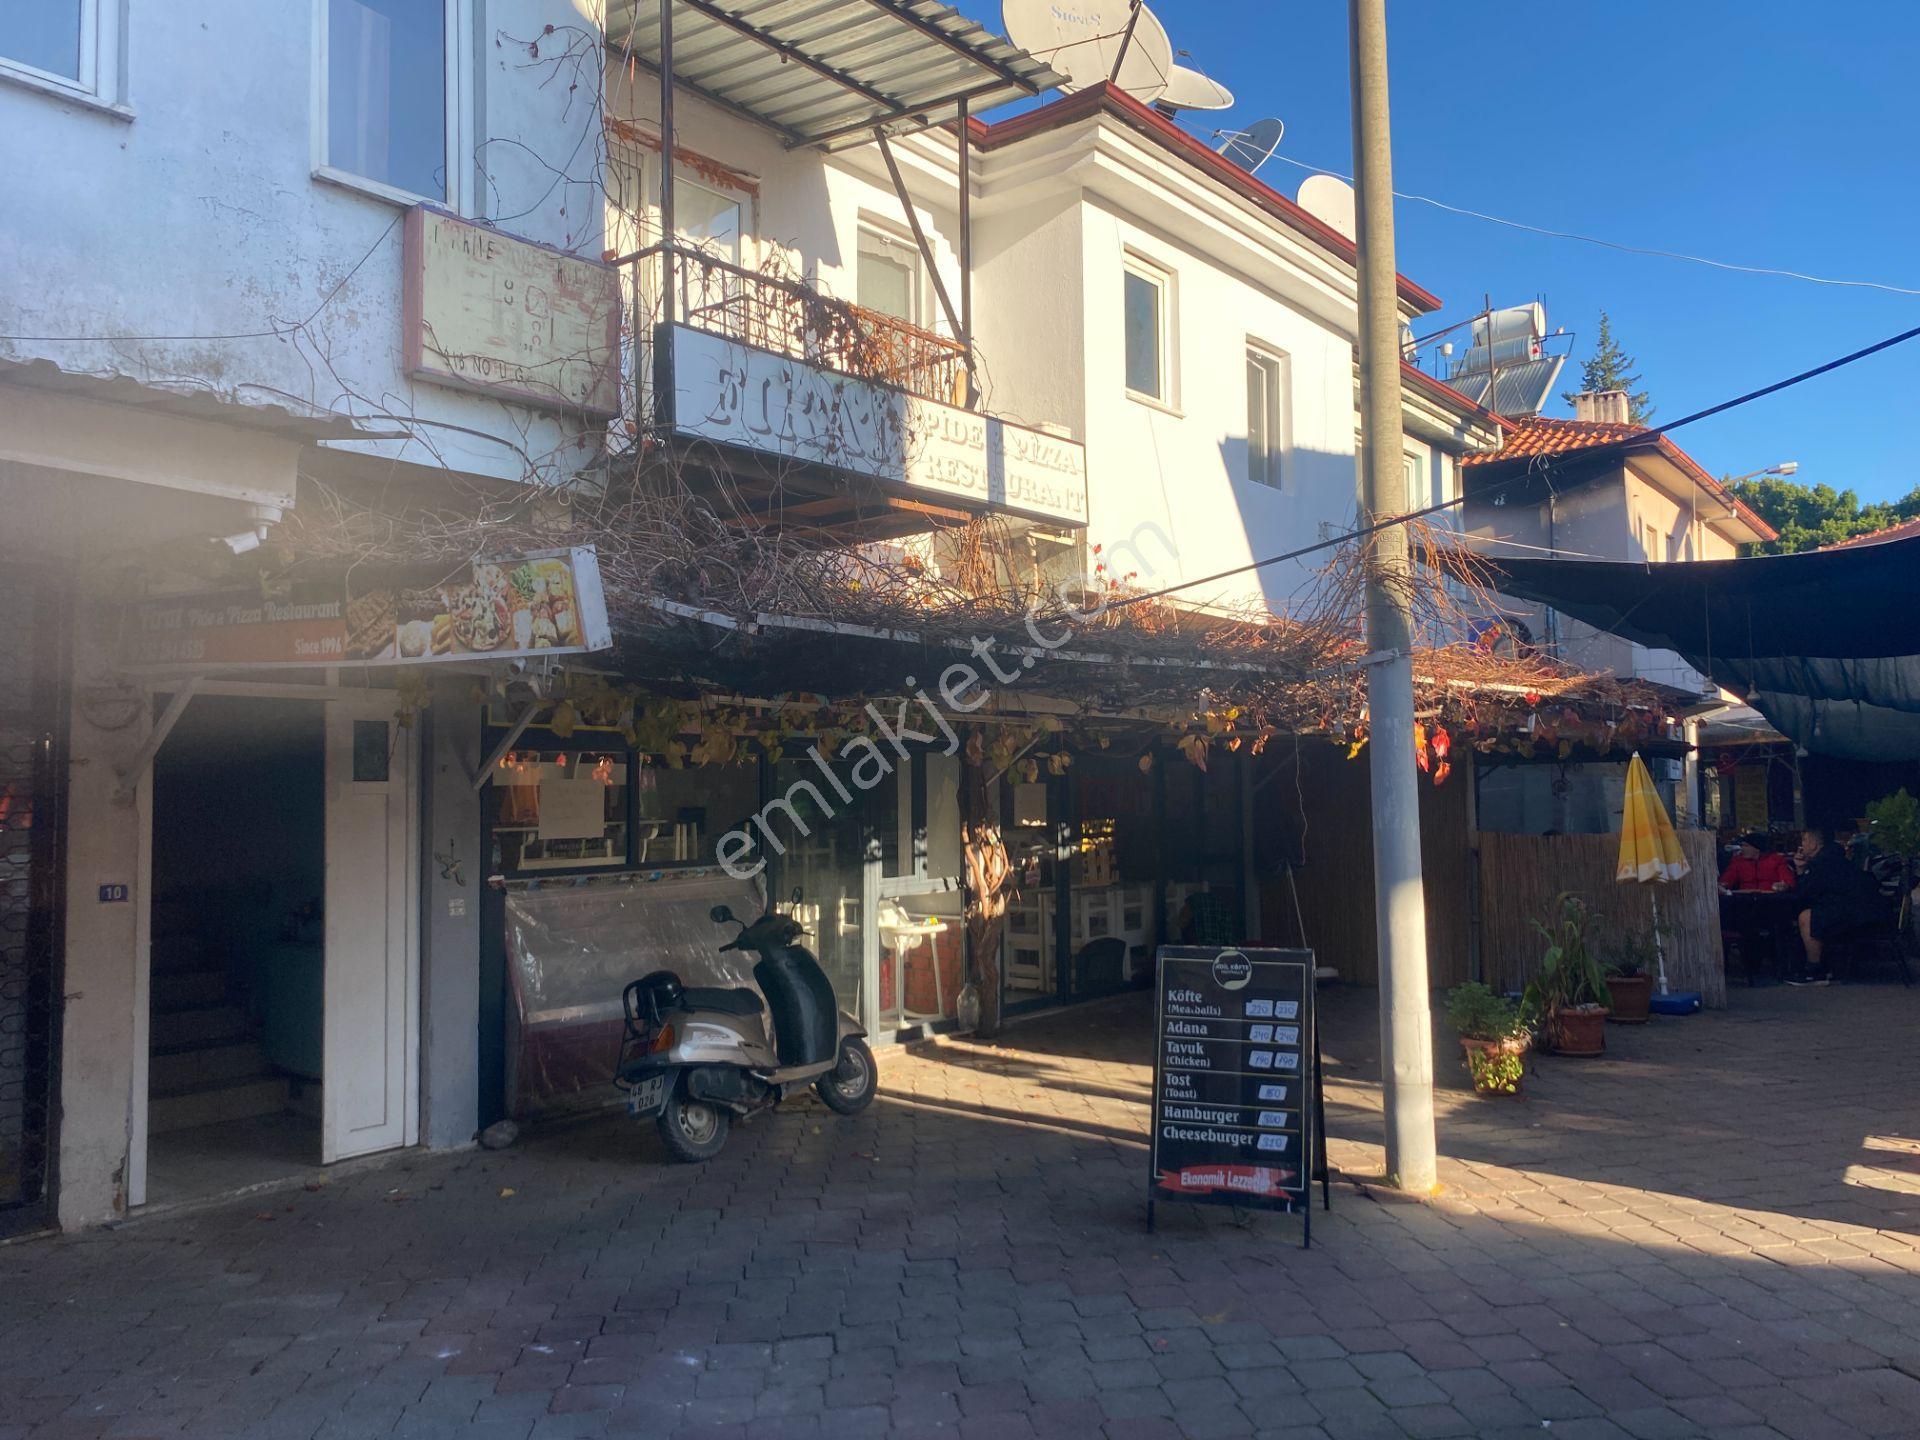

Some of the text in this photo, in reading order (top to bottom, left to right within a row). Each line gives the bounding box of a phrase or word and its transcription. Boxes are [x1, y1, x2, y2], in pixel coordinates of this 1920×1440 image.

[264, 600, 341, 621] Restaurant
[295, 638, 320, 656] Since
[105, 886, 122, 899] 10
[1168, 989, 1202, 1003] Köfte
[1166, 1021, 1208, 1035] Adana
[1166, 1041, 1204, 1055] Tavuk
[1166, 1055, 1211, 1068] (Chicken)
[1165, 1073, 1191, 1087] Tost
[1165, 1087, 1198, 1100] (Toast)
[1164, 1106, 1240, 1124] Hamburger
[1163, 1126, 1255, 1146] Cheeseburger
[1180, 1170, 1226, 1187] Ekonomik
